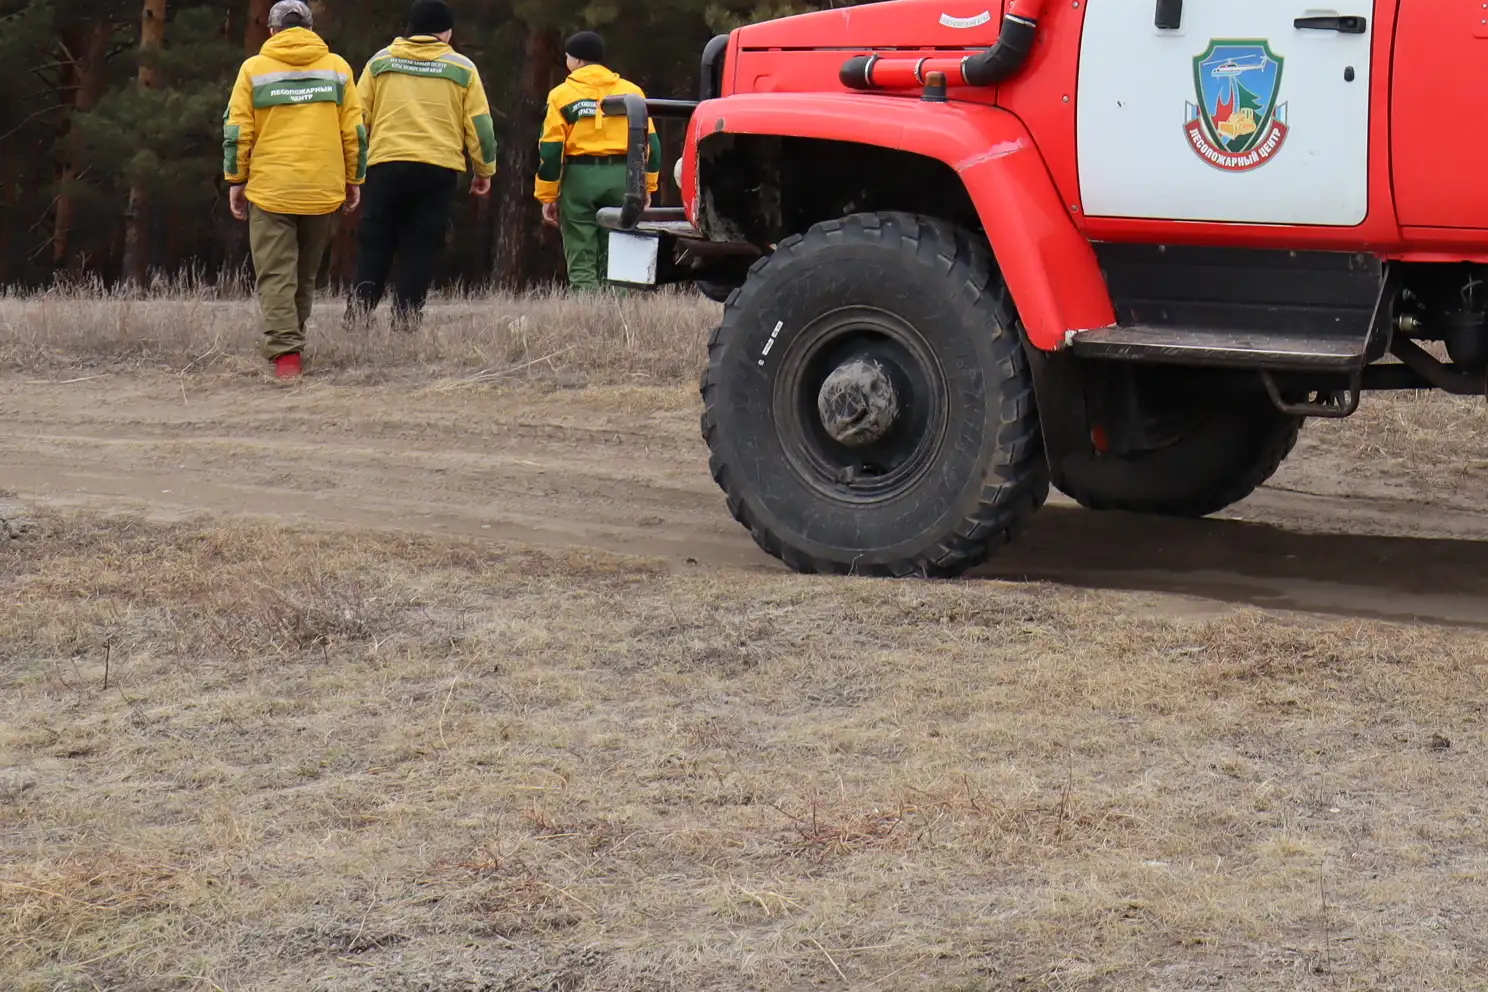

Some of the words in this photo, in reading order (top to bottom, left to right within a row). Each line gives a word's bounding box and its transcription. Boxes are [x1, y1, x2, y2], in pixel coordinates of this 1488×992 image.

[270, 85, 333, 97] ЛЕСОПОЖАРНЫЙ
[1189, 128, 1259, 167] ЛЕСОПОЖАРНЫЙ
[1259, 127, 1282, 157] ЦЕНТР
